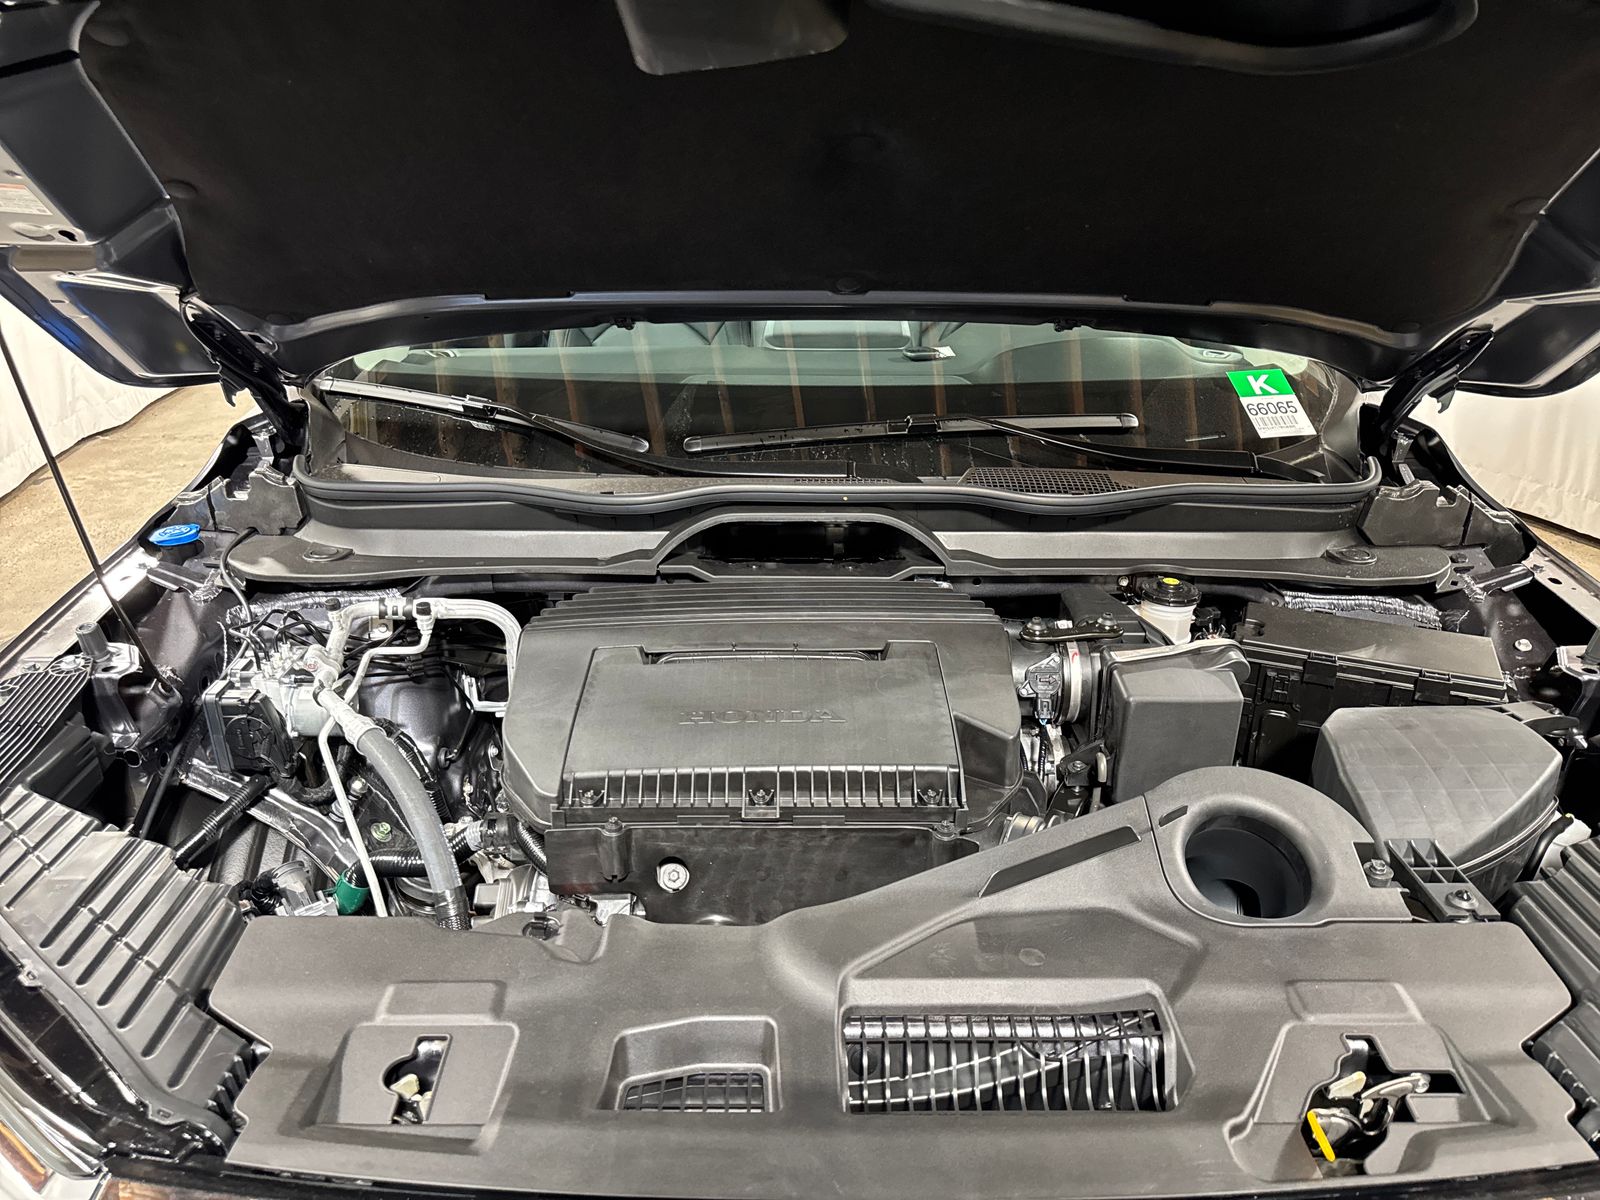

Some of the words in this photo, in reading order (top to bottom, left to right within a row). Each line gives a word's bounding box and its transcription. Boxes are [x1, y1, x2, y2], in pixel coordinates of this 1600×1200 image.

[1246, 374, 1280, 395] K
[1246, 401, 1298, 416] 66065
[678, 708, 846, 725] HONDA
